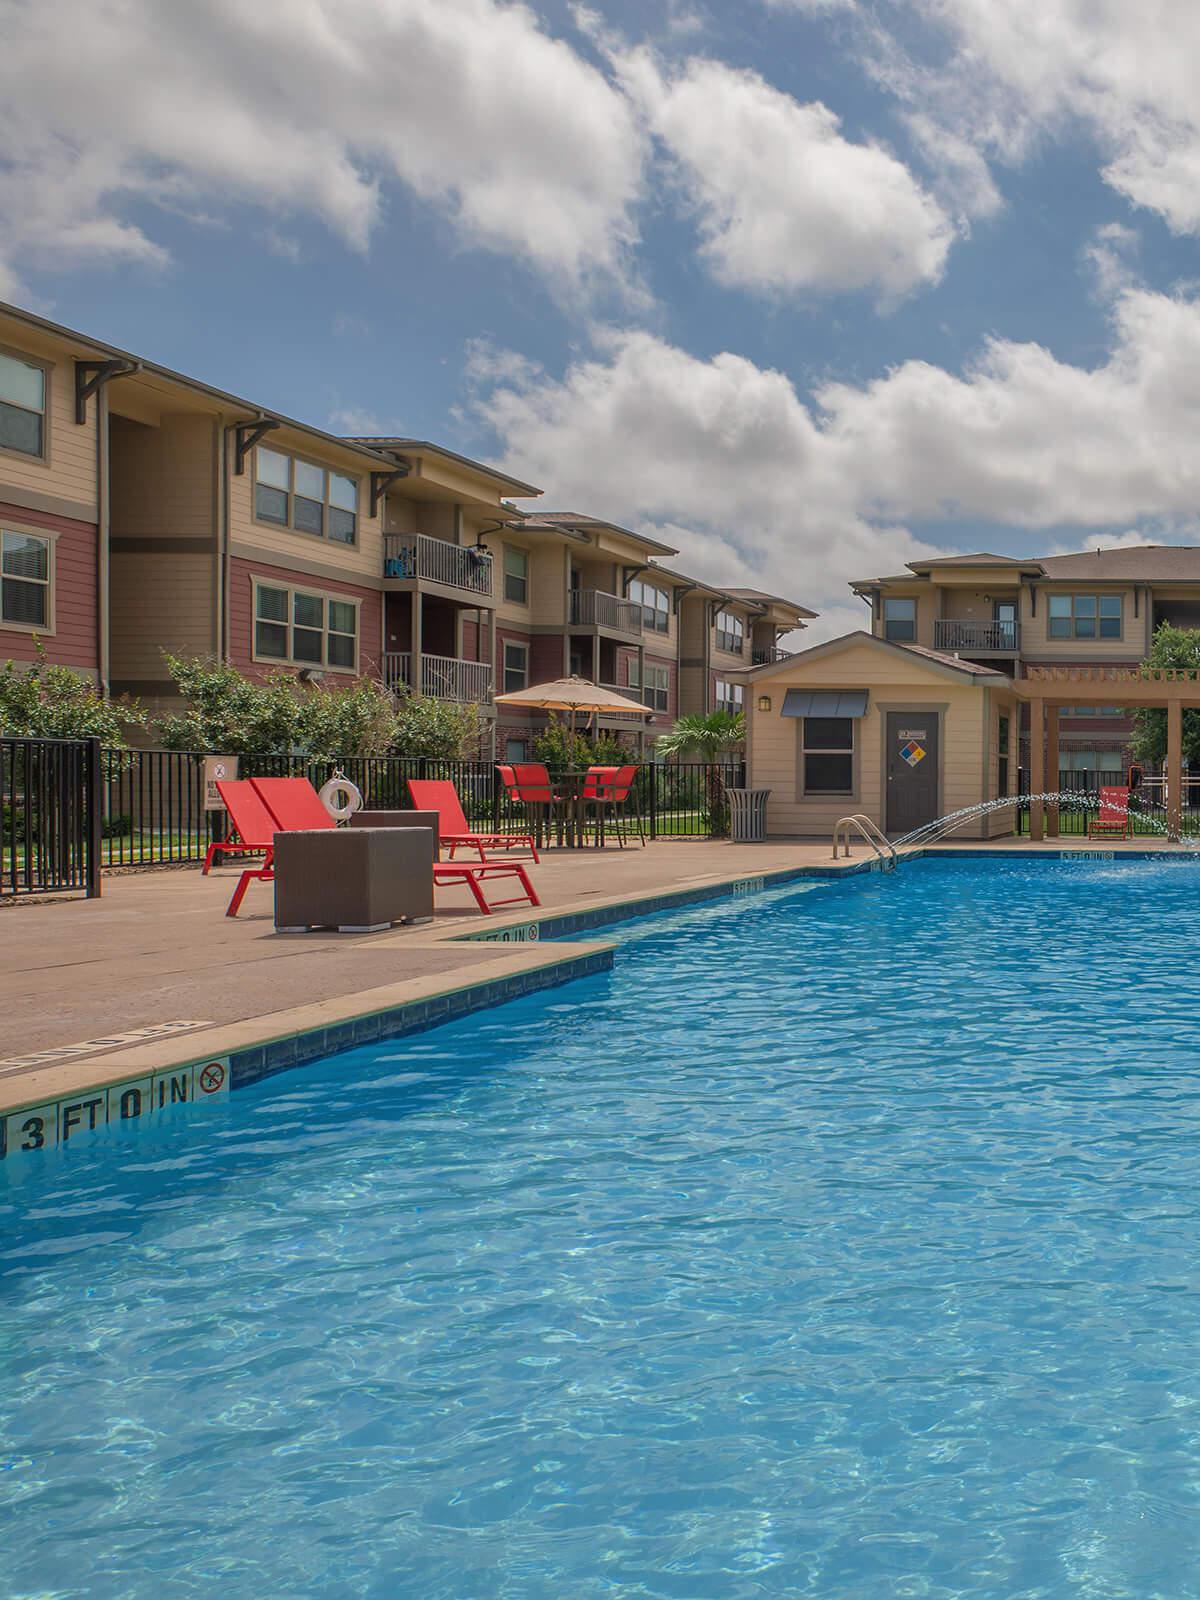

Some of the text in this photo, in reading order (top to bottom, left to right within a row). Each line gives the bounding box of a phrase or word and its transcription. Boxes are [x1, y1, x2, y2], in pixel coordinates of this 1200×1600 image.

[21, 1073, 187, 1150] 3 FT 0 IN
